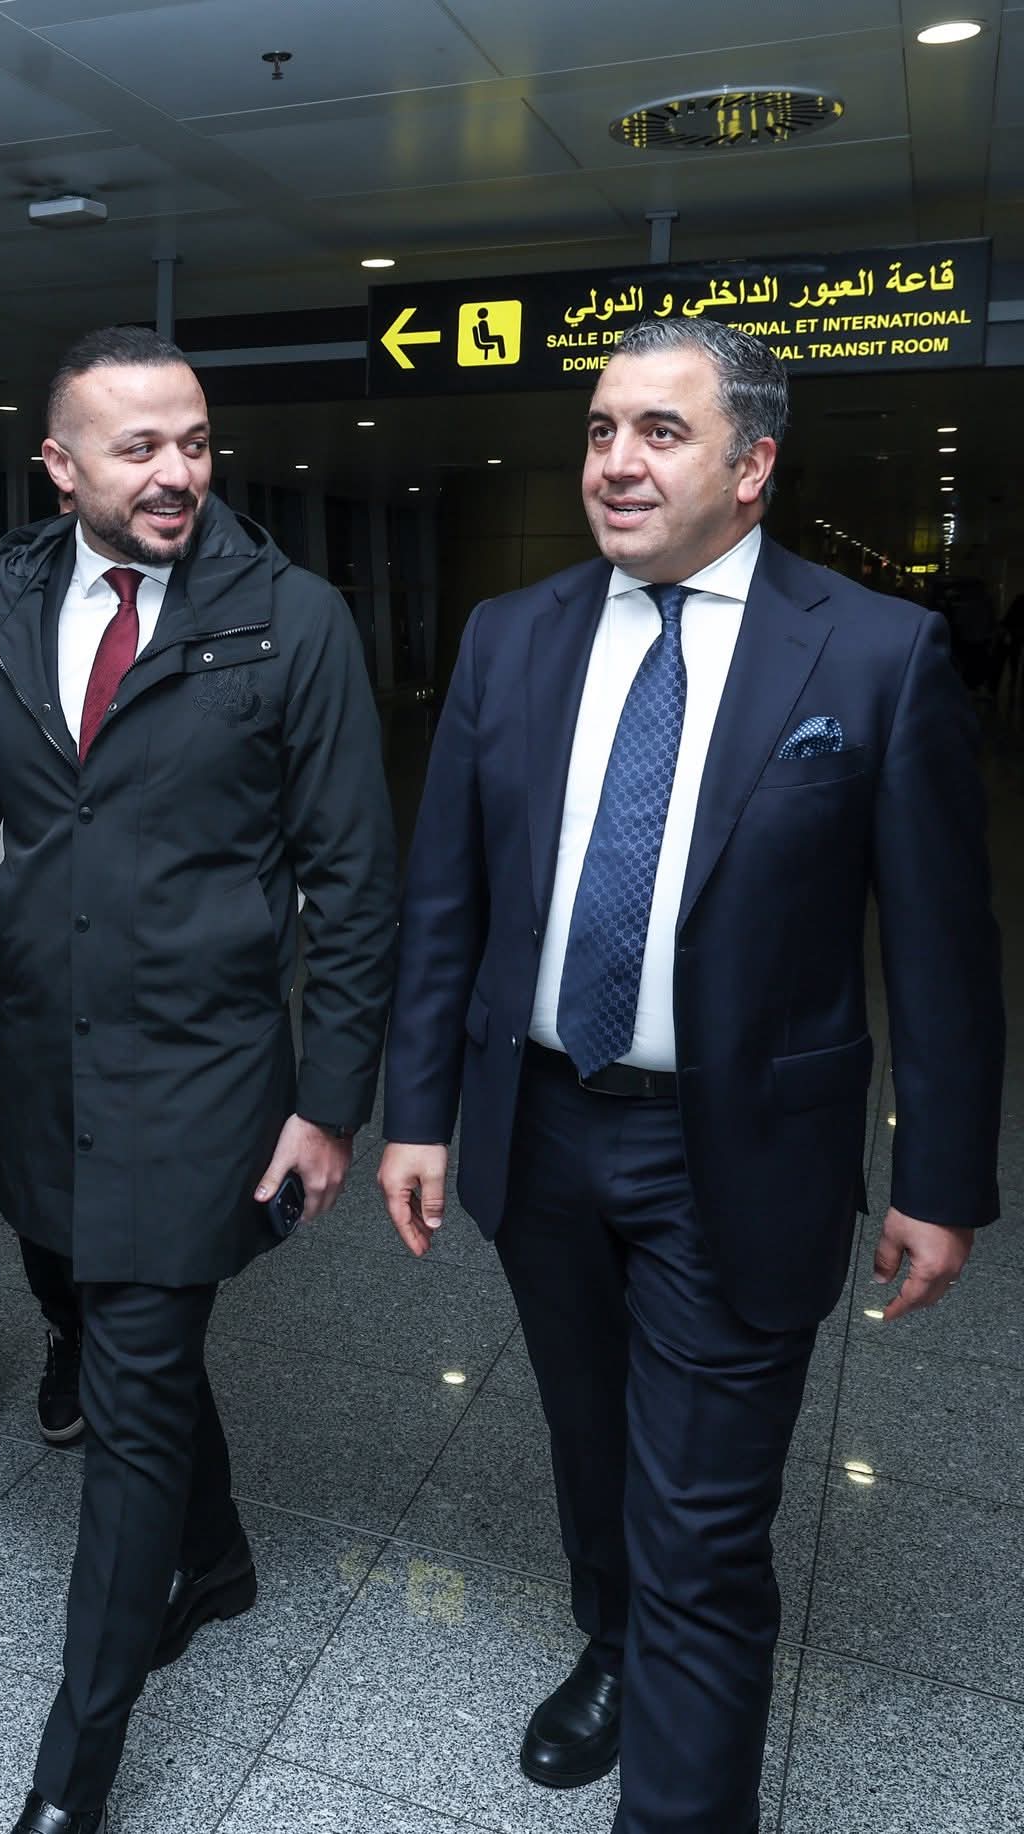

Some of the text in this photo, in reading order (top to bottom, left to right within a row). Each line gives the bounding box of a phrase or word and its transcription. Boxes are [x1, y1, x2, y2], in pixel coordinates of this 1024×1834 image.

[564, 259, 955, 327] قاعة العبور الداخلي و الدولي
[546, 332, 598, 348] SALLE
[795, 318, 819, 334] ET
[822, 310, 971, 332] INTERNATIONAL
[562, 355, 609, 372] DOME
[809, 340, 887, 360] TRANSIT
[891, 337, 950, 354] ROOM
